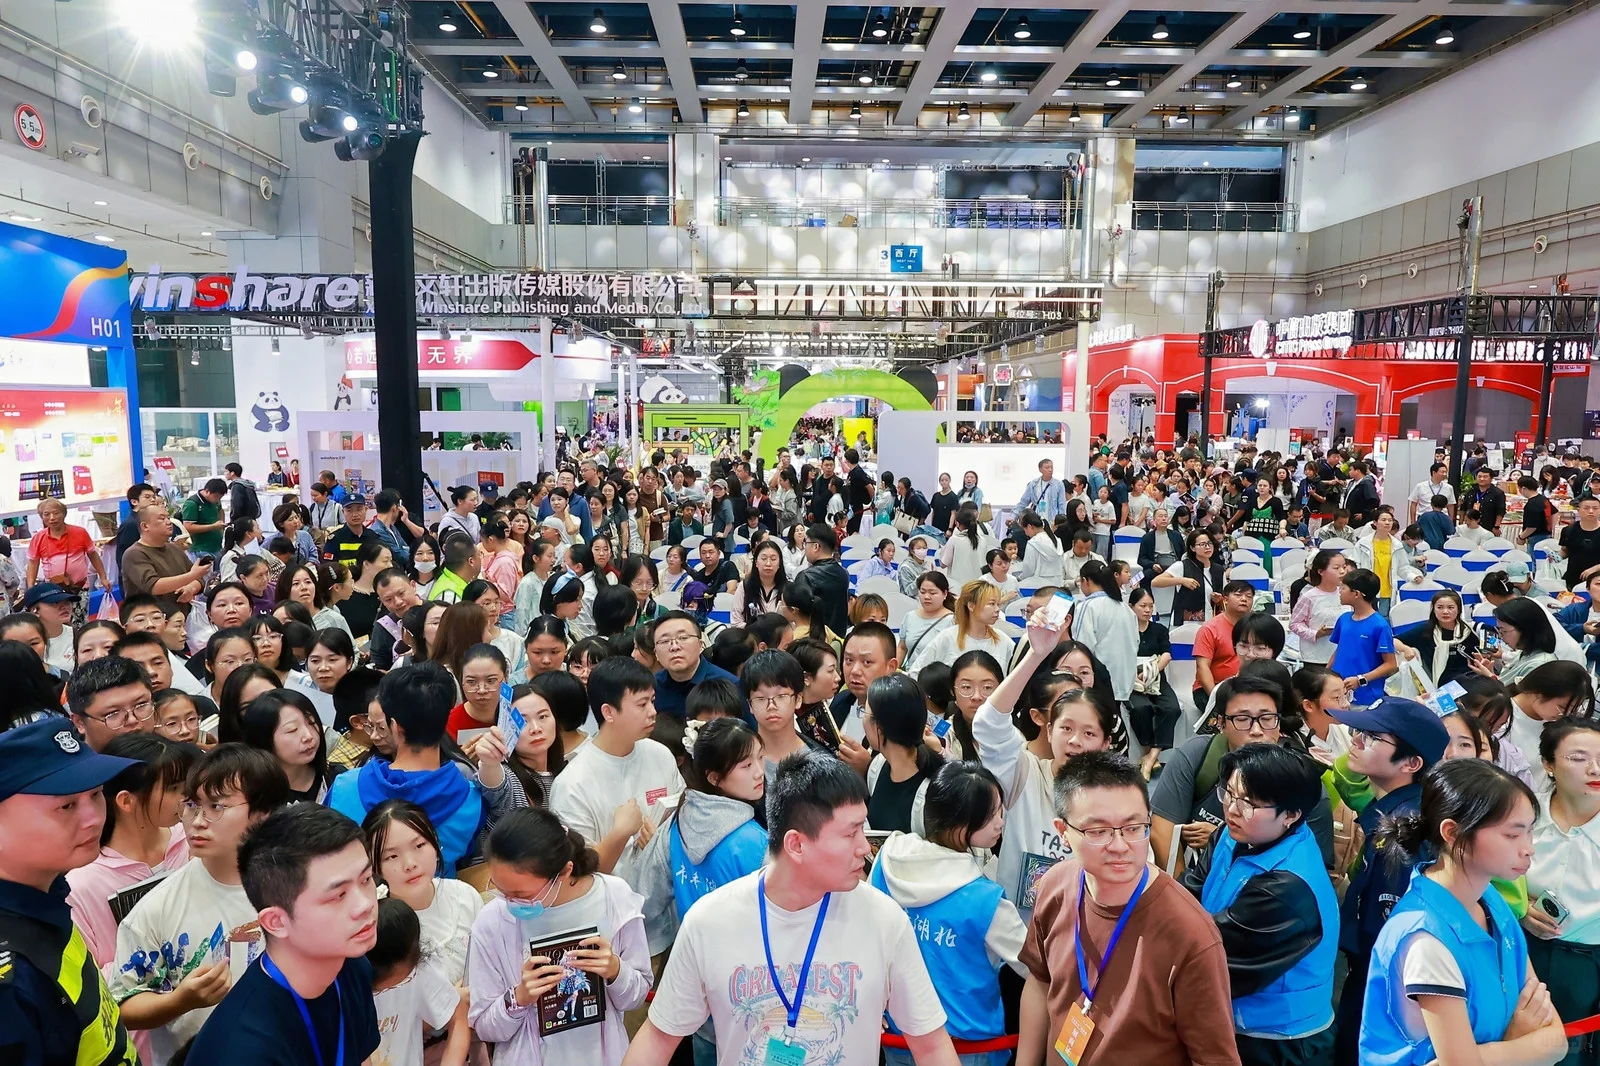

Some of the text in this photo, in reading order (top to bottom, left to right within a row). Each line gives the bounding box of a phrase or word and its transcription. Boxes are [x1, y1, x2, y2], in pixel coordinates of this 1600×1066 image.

[881, 250, 889, 260] 3
[895, 248, 919, 258] 西厅
[421, 301, 490, 314] Winshare
[493, 300, 569, 316] Publishing
[574, 301, 601, 314] and
[605, 301, 649, 314] Media
[91, 317, 121, 338] H01
